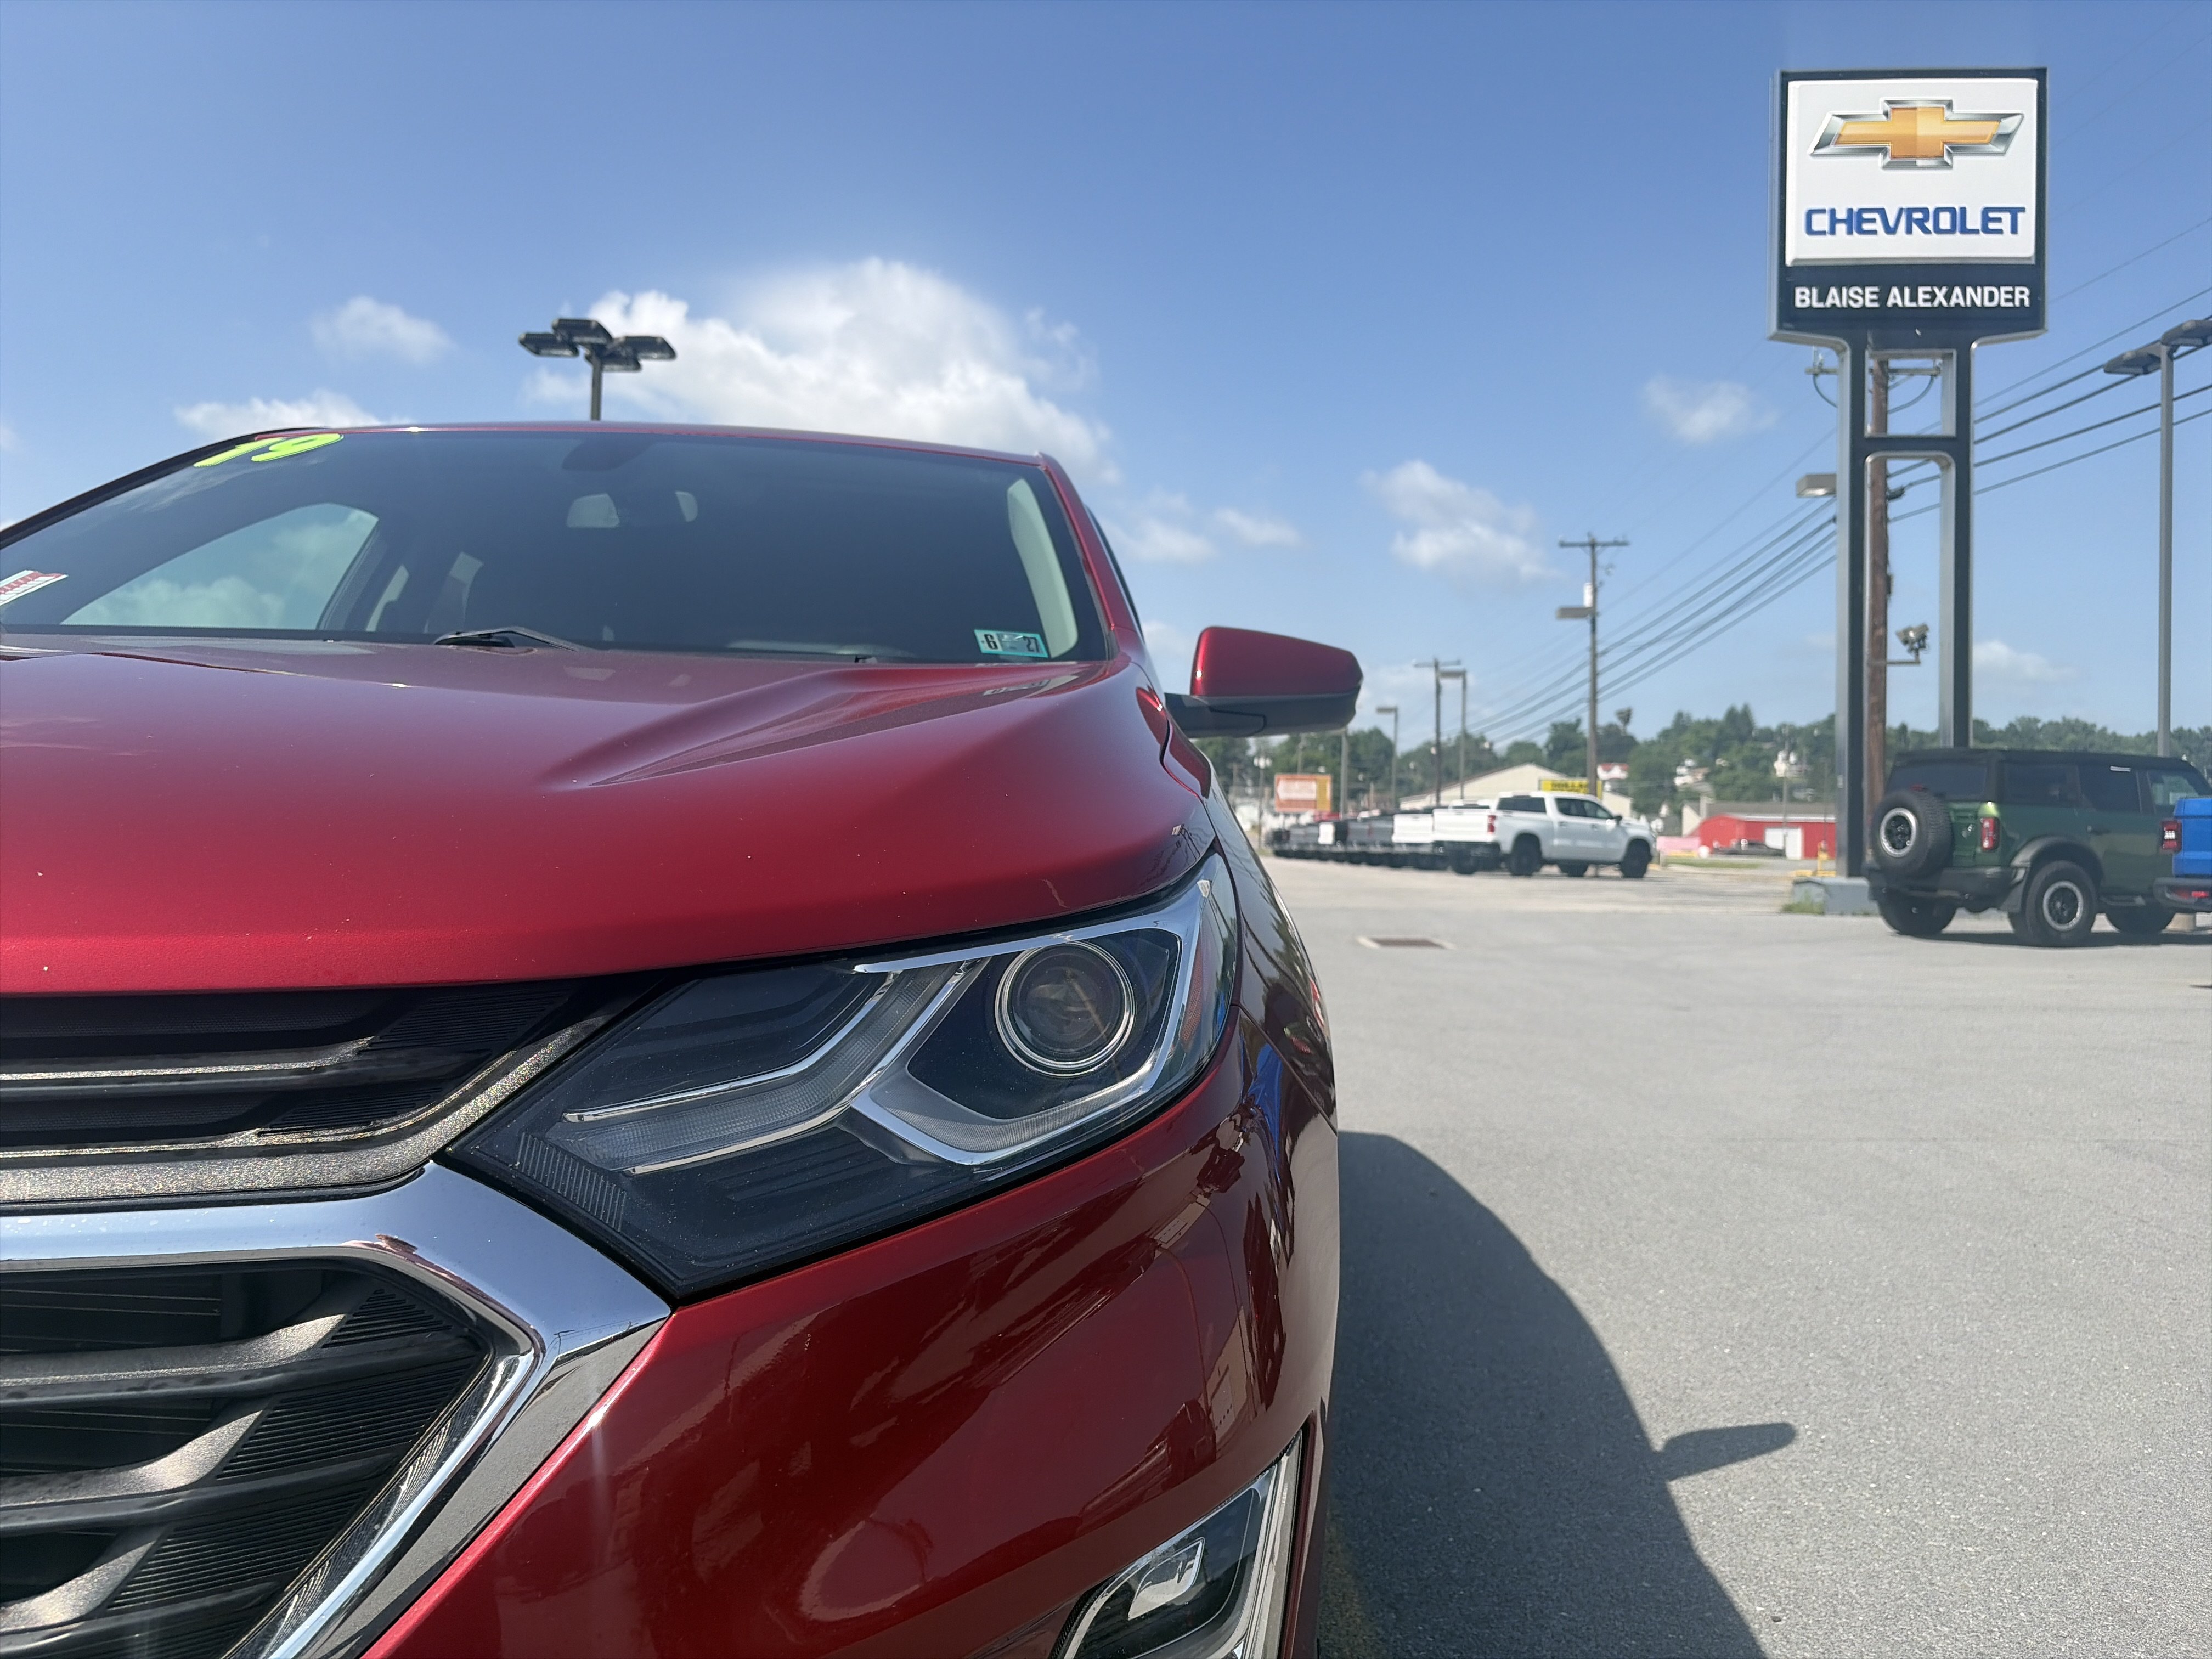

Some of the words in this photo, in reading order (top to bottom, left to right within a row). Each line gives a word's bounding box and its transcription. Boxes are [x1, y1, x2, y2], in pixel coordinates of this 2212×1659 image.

[1805, 206, 2025, 235] CHEVROLET
[1795, 285, 1880, 308] BLAISE
[1887, 285, 2030, 308] ALEXANDER
[984, 634, 998, 650] 6
